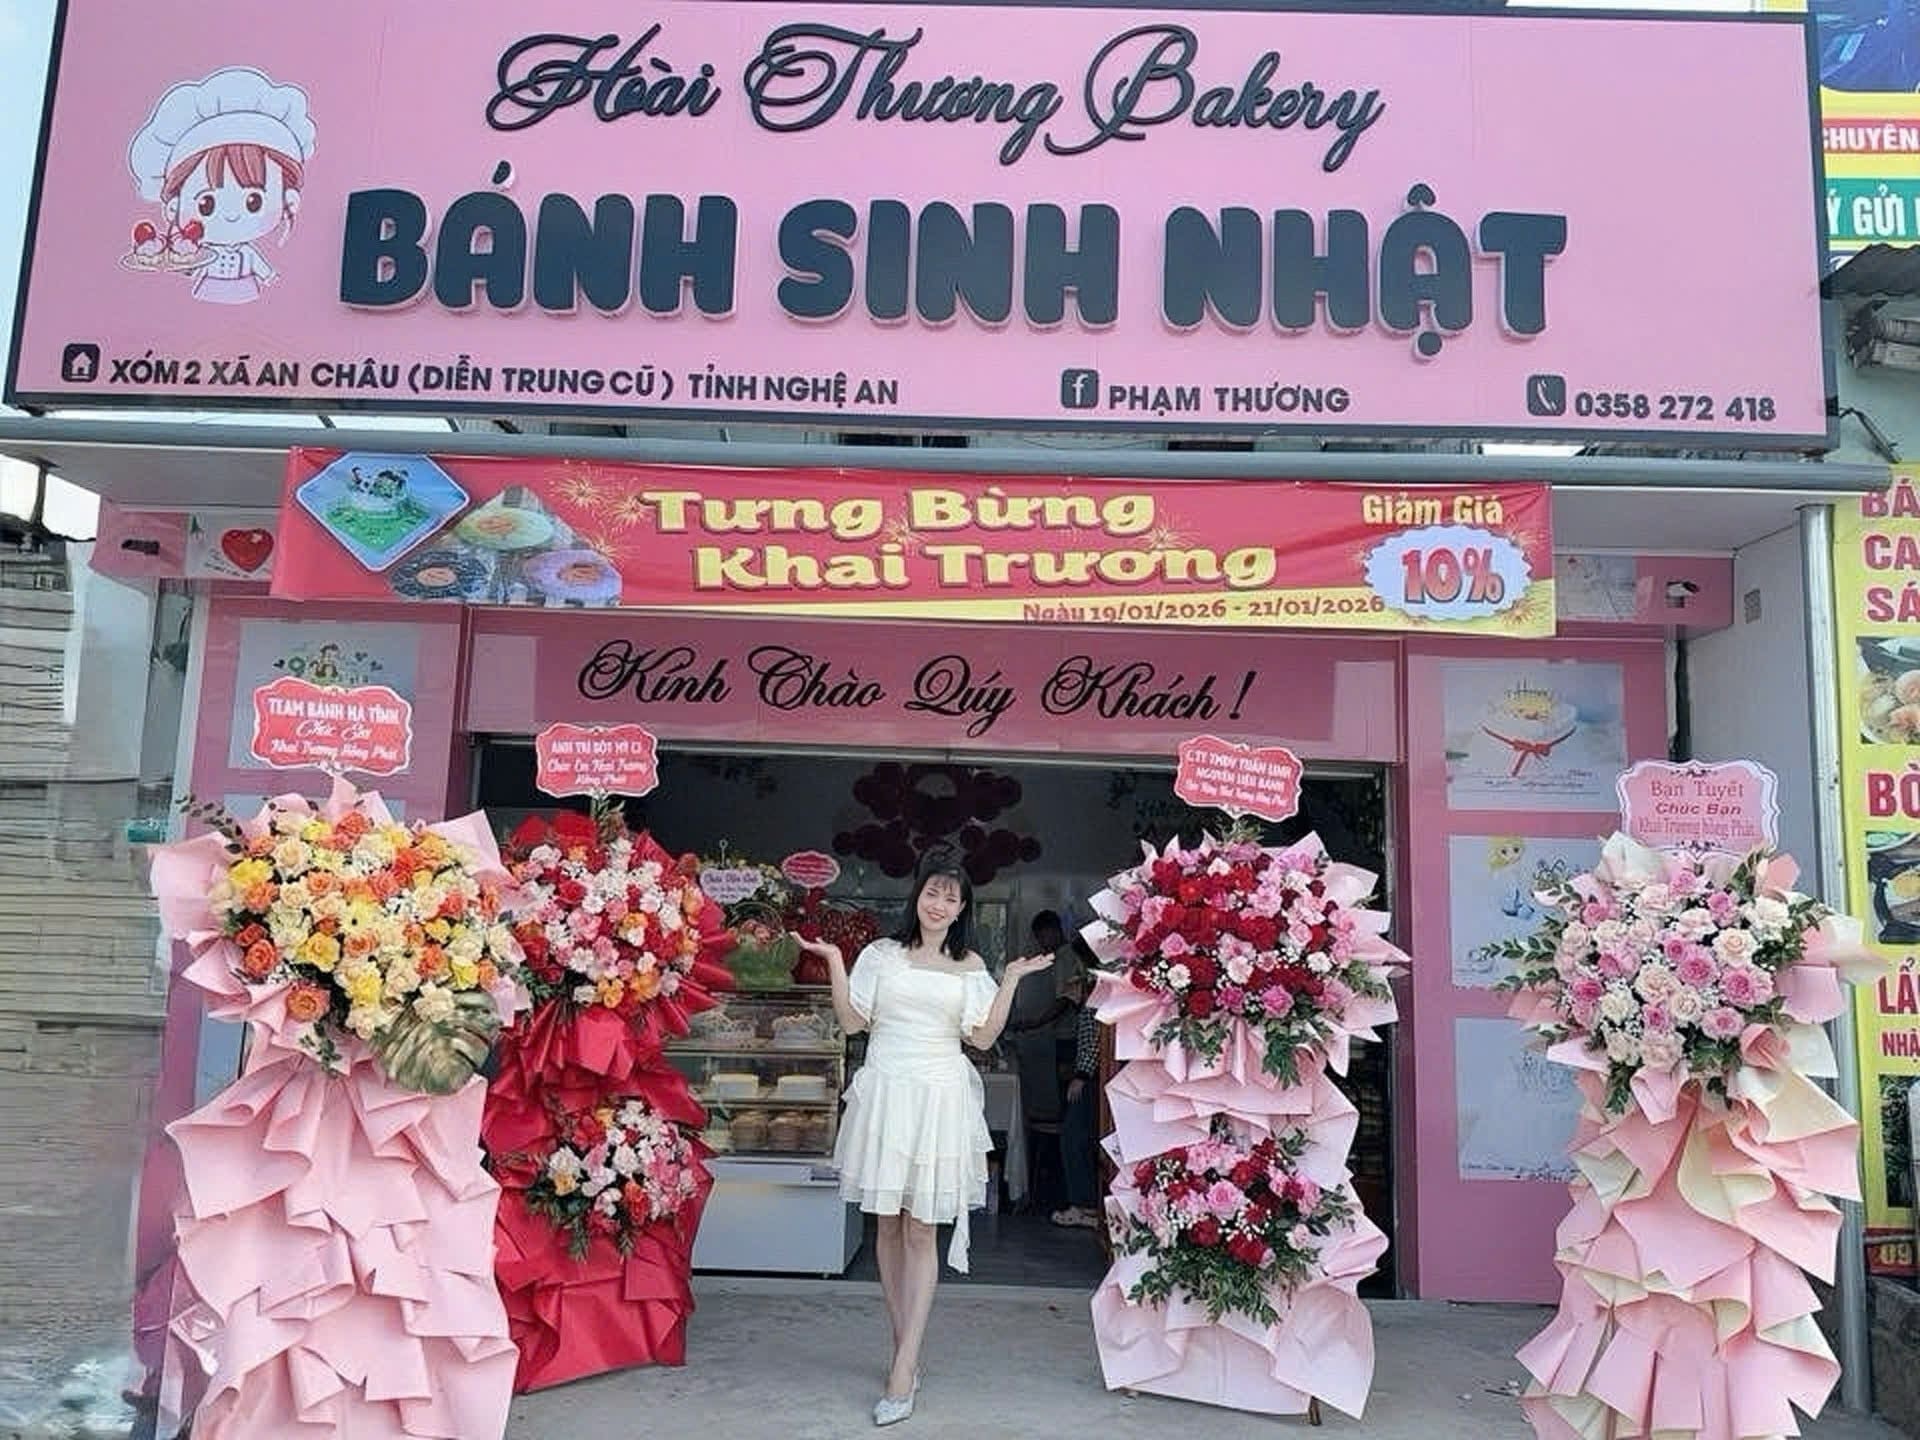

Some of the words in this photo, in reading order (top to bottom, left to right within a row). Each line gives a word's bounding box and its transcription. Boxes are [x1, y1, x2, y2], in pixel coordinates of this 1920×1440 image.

[486, 23, 721, 131] Hoài
[744, 23, 1063, 165] Thương
[1044, 23, 1386, 173] Bakery
[1852, 183, 1907, 236] GỬI
[340, 160, 738, 318] BÁNH
[777, 198, 1120, 328] SINH
[1161, 183, 1568, 361] NHẬT
[109, 350, 177, 385] XÓM
[186, 361, 201, 384] 2
[208, 355, 248, 385] XÃ
[255, 360, 299, 386] AN
[310, 358, 399, 388] CHÂU
[407, 354, 493, 394] (DIỄN
[502, 367, 605, 395] TRUNG
[688, 364, 757, 400] TỈNH
[763, 371, 848, 409] NGHỆ
[853, 379, 899, 405] AN
[1109, 385, 1201, 417] PHẠM
[1214, 381, 1350, 412] THƯƠNG
[1575, 392, 1650, 419] 0358
[1659, 395, 1714, 420] 272
[1725, 396, 1776, 421] 418
[640, 490, 884, 542] Tưng
[911, 485, 1155, 536] Bừng
[1363, 493, 1442, 525] Giảm
[1453, 495, 1503, 524] Giá
[691, 543, 910, 591] Khai
[922, 544, 1277, 590] Trương
[1402, 547, 1505, 604] 10%
[1092, 599, 1227, 621] 19/01/2026
[1248, 596, 1385, 617] 21/01/2026
[268, 698, 304, 716] TEAM
[578, 640, 732, 703] Kính
[747, 645, 886, 710] Chào
[904, 655, 1016, 738] Quý
